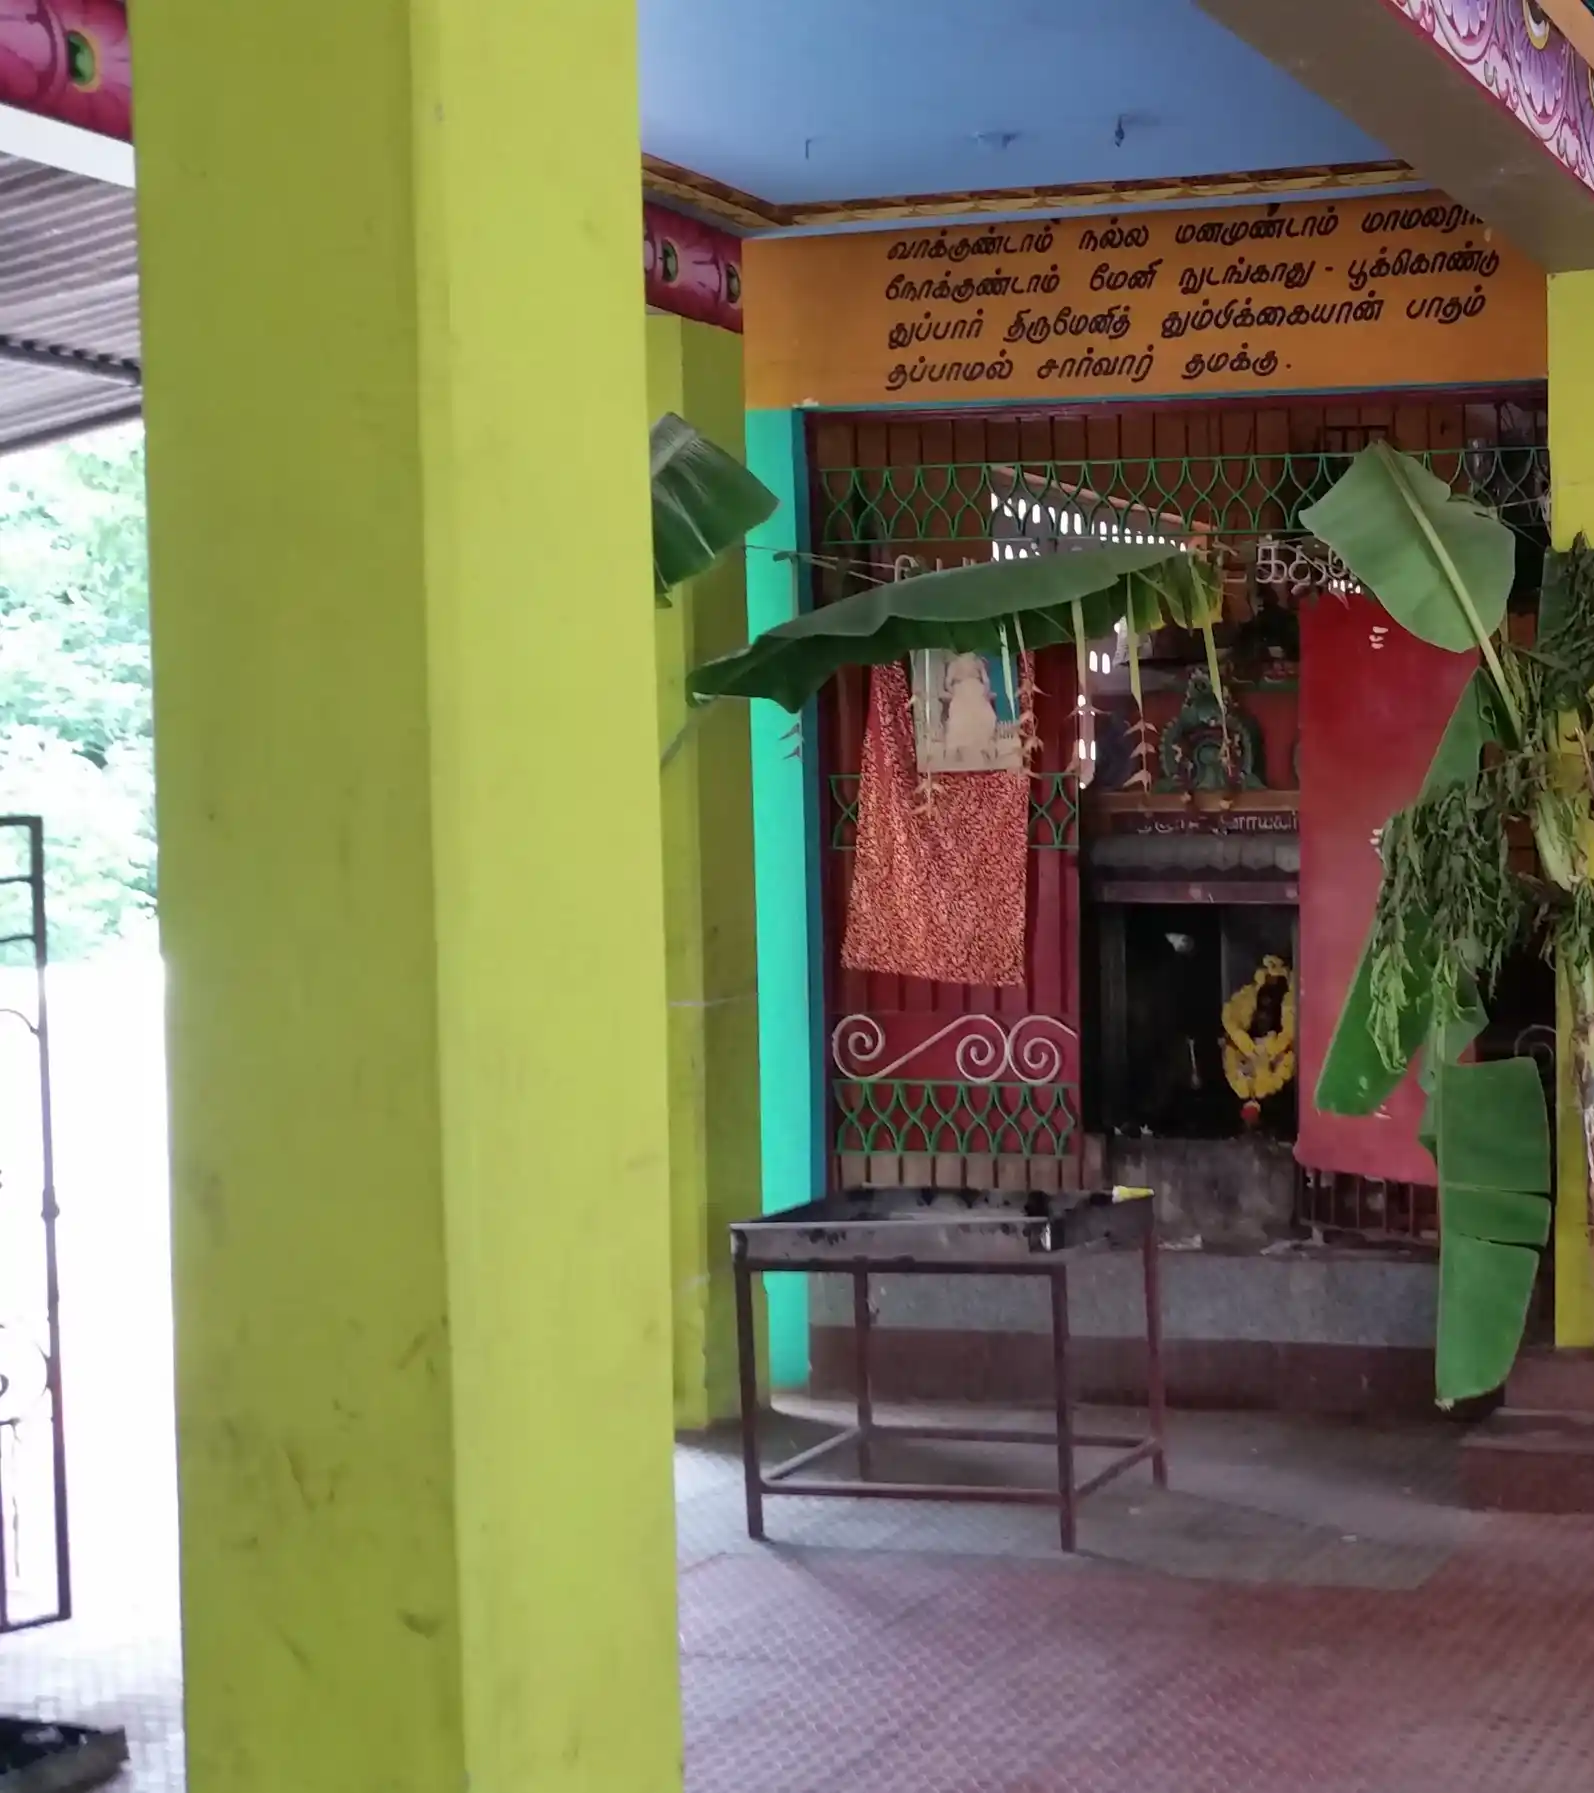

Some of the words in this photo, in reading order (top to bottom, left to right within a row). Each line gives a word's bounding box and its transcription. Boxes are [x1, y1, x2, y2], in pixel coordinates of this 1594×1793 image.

[887, 226, 1054, 262] வாக்குண்டாம்
[1079, 217, 1149, 251] நல்ல
[885, 264, 1061, 303] நோக்குண்டாம்
[1090, 259, 1163, 292] மேனி
[1179, 256, 1315, 294] நுடங்காது
[1348, 240, 1501, 291] பூக்கொண்டு
[888, 308, 984, 350] துப்பார்
[1003, 305, 1131, 343] திருமேனித்
[1407, 285, 1487, 324] பாதம்
[885, 349, 1014, 391] தப்பாமல்
[1037, 344, 1154, 383] சார்வார்
